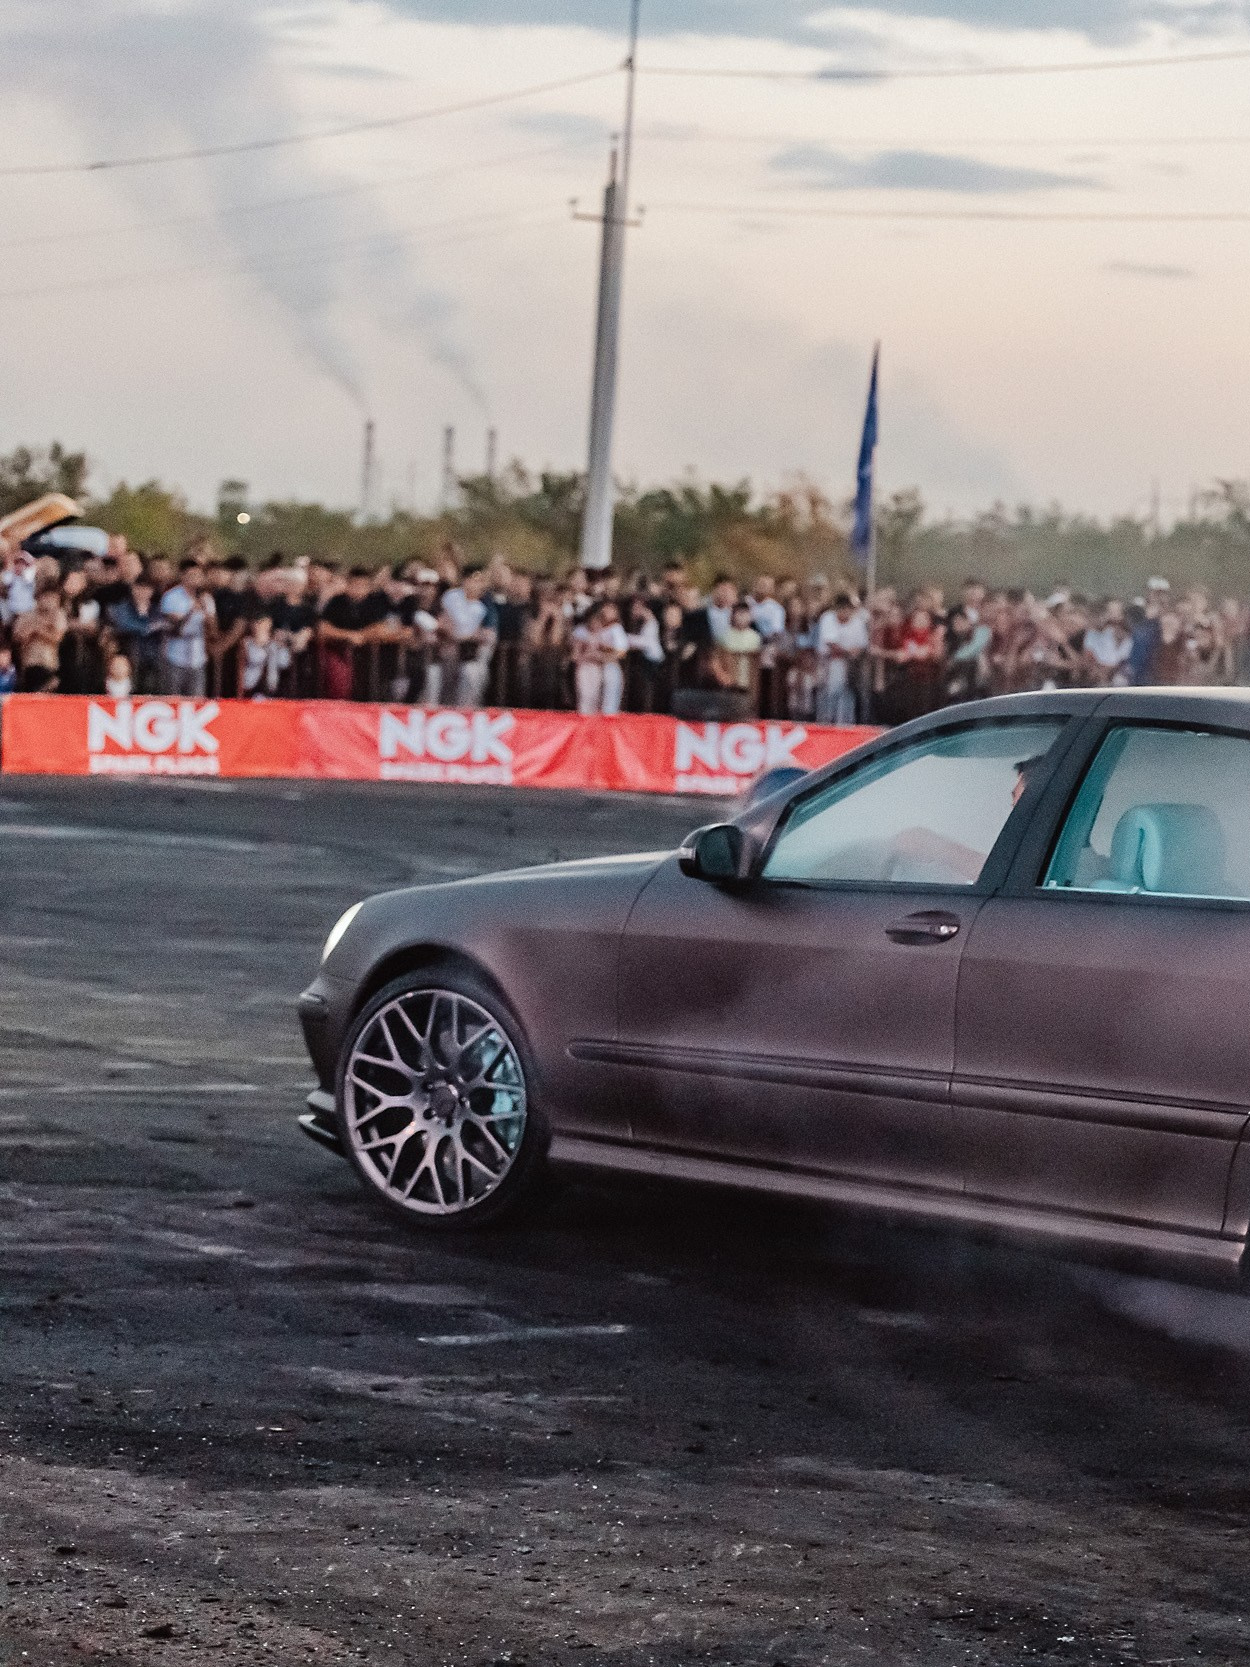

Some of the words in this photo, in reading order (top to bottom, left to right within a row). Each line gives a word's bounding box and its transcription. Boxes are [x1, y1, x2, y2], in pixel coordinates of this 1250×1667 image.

[87, 700, 220, 753] NGK
[379, 708, 515, 764] NGK
[675, 722, 809, 775] NGK
